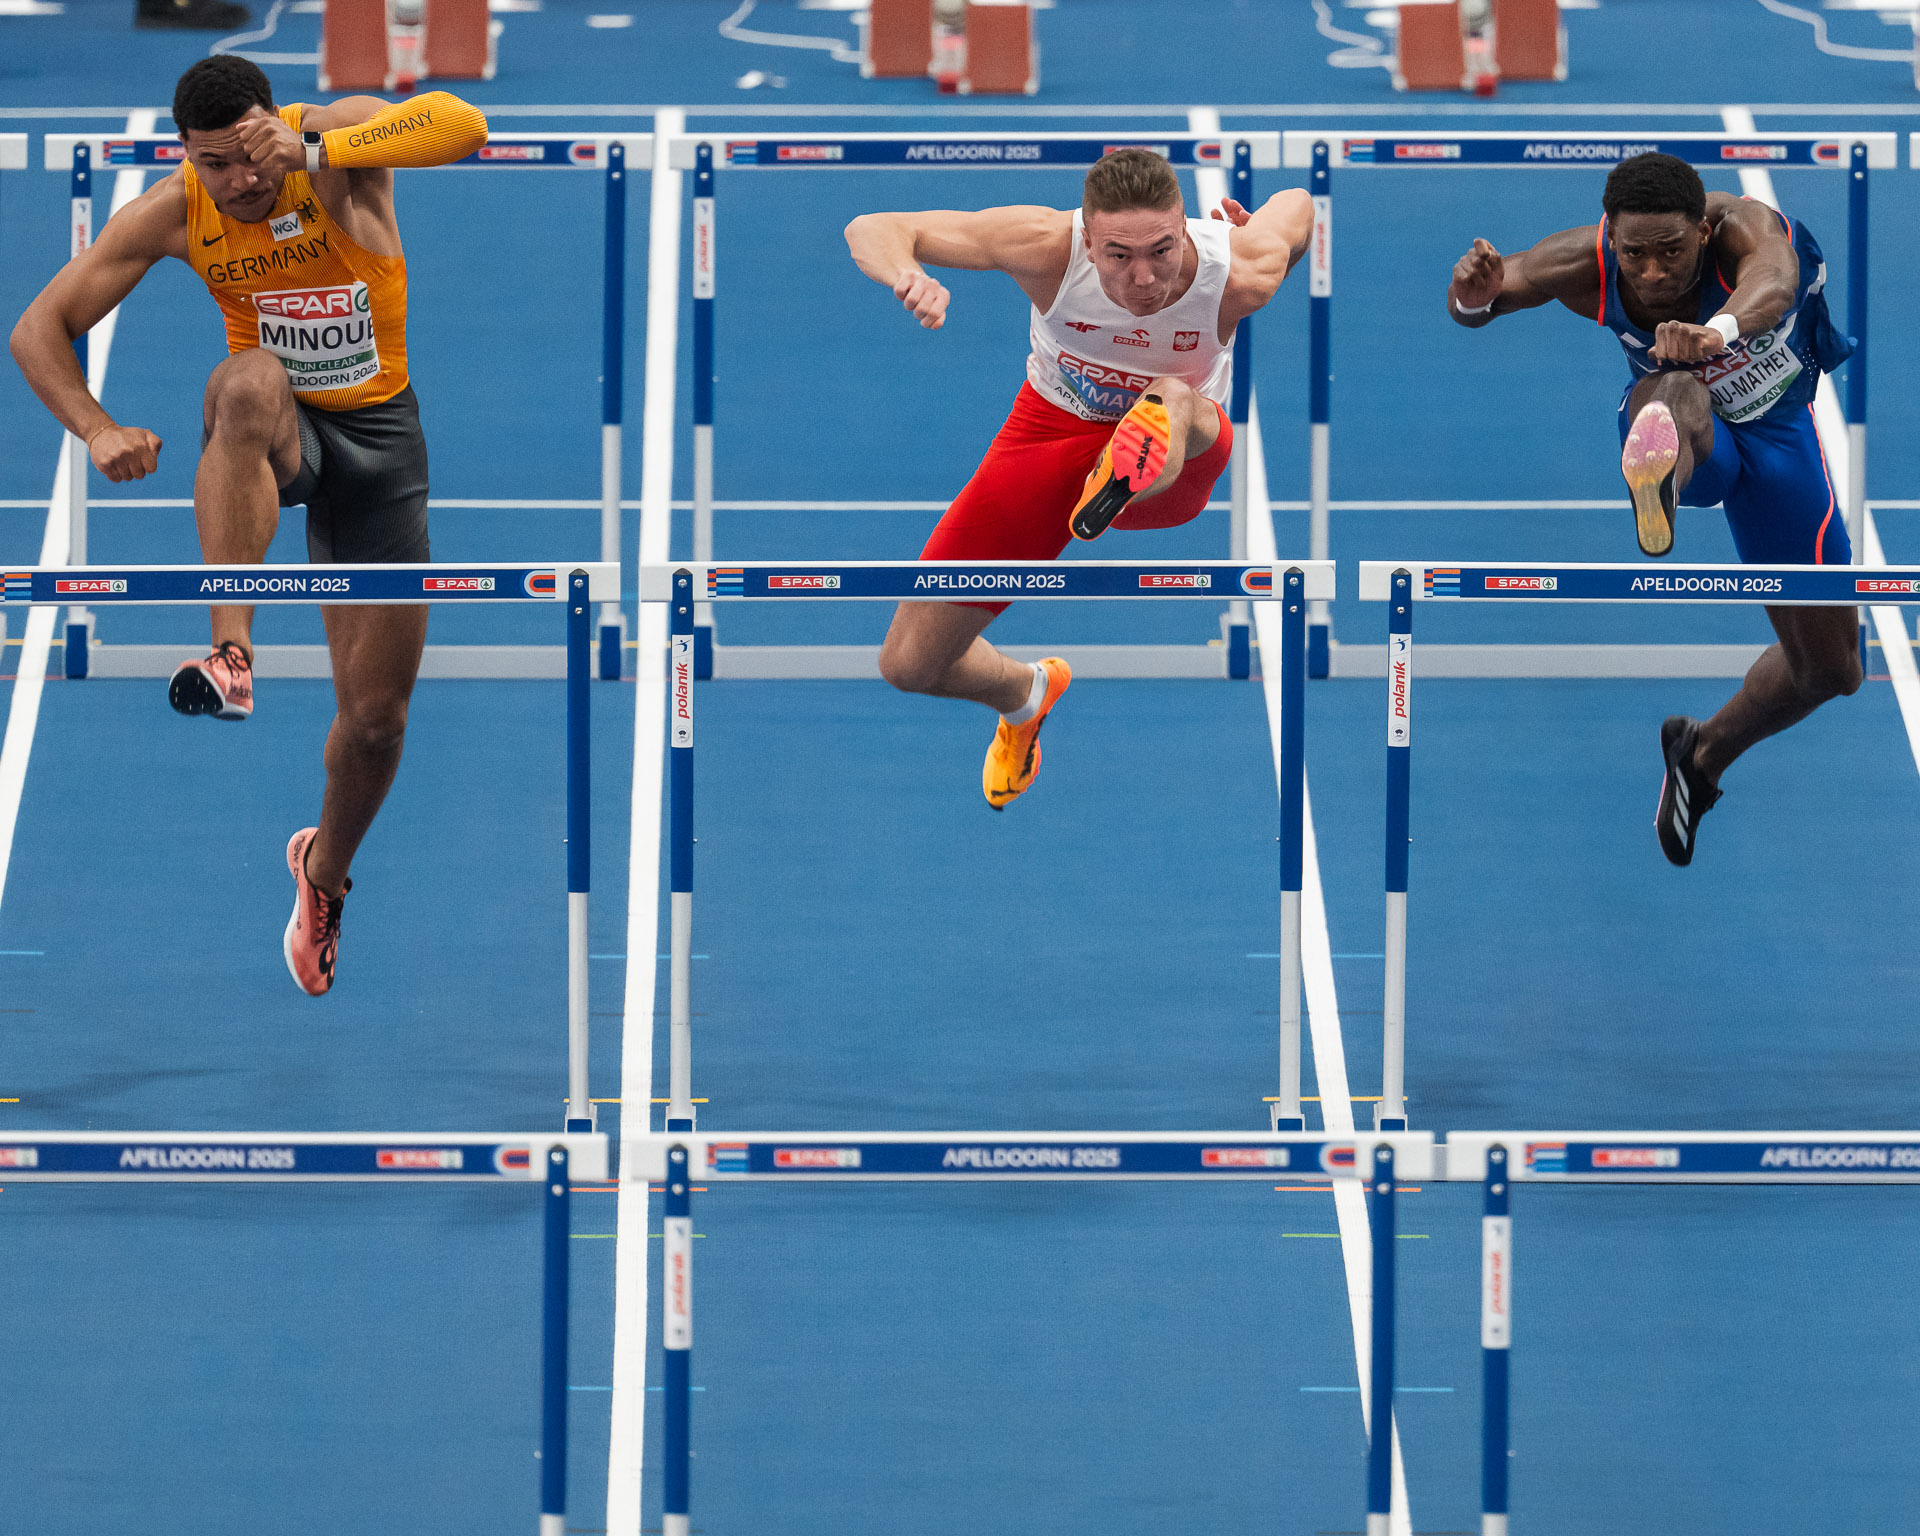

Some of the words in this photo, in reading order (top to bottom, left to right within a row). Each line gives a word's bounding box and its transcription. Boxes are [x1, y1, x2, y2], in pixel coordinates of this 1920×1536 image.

[348, 110, 434, 147] GERMANY
[905, 144, 1001, 160] APELDOORN
[1003, 144, 1042, 160] 2025
[1523, 144, 1621, 159] APELDOORN
[271, 217, 299, 236] WGV
[207, 231, 331, 284] GERMANY
[258, 292, 350, 316] SPAR
[1115, 338, 1149, 348] ORLEN
[292, 359, 316, 371] RUN
[318, 356, 357, 370] CLEAN
[1059, 356, 1150, 390] SPAR
[289, 373, 350, 386] LDOORN
[353, 362, 378, 381] 2025
[1710, 347, 1790, 407] OU-MATHEY
[1060, 365, 1137, 409] SZYMAN
[1745, 386, 1781, 413] CLEAN
[1136, 434, 1153, 470] NITRO
[68, 581, 110, 591] SPAR
[199, 578, 306, 593] APELDOORN
[310, 578, 350, 592] 2025
[436, 580, 478, 589] SPAR
[781, 577, 823, 587] SPAR
[914, 574, 1022, 589] APELDOORN
[1025, 575, 1066, 589] 2025
[1152, 577, 1194, 585] SPAR
[1497, 579, 1540, 588] SPAR
[1630, 577, 1739, 592] APELDOORN
[1742, 578, 1783, 593] 2025
[1868, 582, 1911, 591] SPAR
[675, 661, 690, 720] polanik
[1392, 660, 1407, 719] polanik
[119, 1149, 245, 1168] APELDOORN
[248, 1149, 295, 1168] 2025
[942, 1148, 1069, 1167] APELDOORN
[1071, 1148, 1120, 1167] 2025
[1760, 1148, 1888, 1167] APELDOORN
[1889, 1148, 1920, 1167] 202
